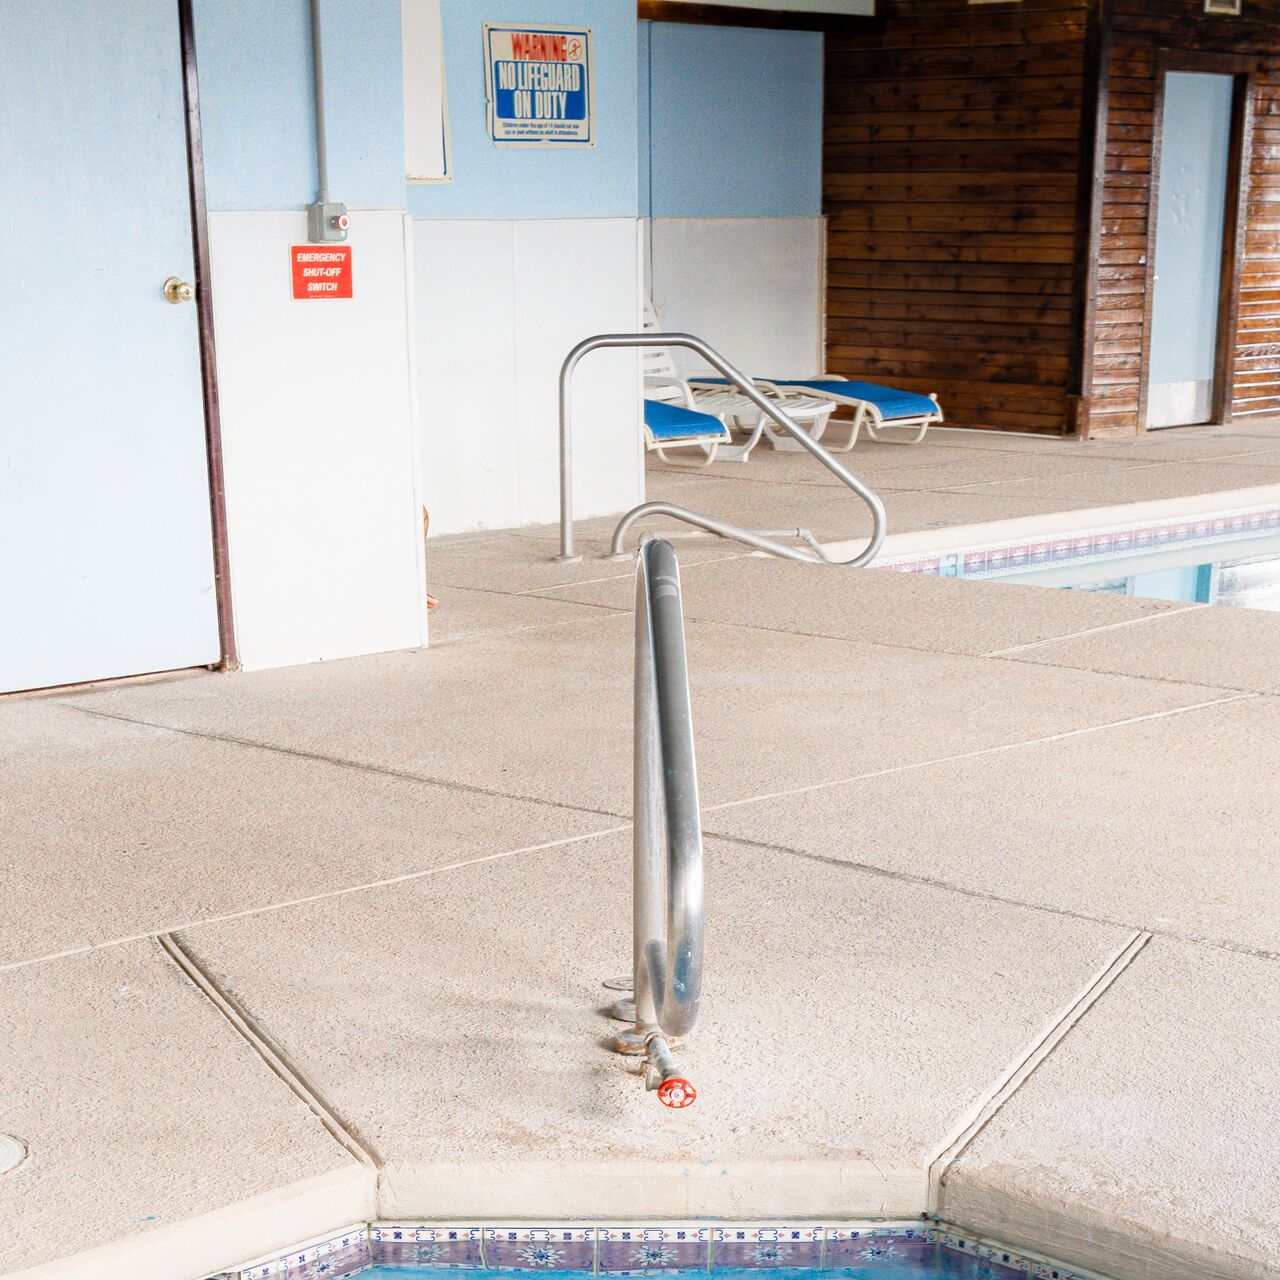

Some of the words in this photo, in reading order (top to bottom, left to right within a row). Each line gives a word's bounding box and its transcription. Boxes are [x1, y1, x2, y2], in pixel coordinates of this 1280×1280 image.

[511, 33, 568, 62] WARNING
[498, 61, 516, 90] NO
[517, 62, 580, 91] LIFEGUARD
[514, 90, 532, 119] ON
[535, 91, 568, 119] DUTY
[297, 252, 346, 262] EMERGENCY
[303, 267, 342, 277] SHUT-OFF
[307, 282, 338, 292] SWITCH
